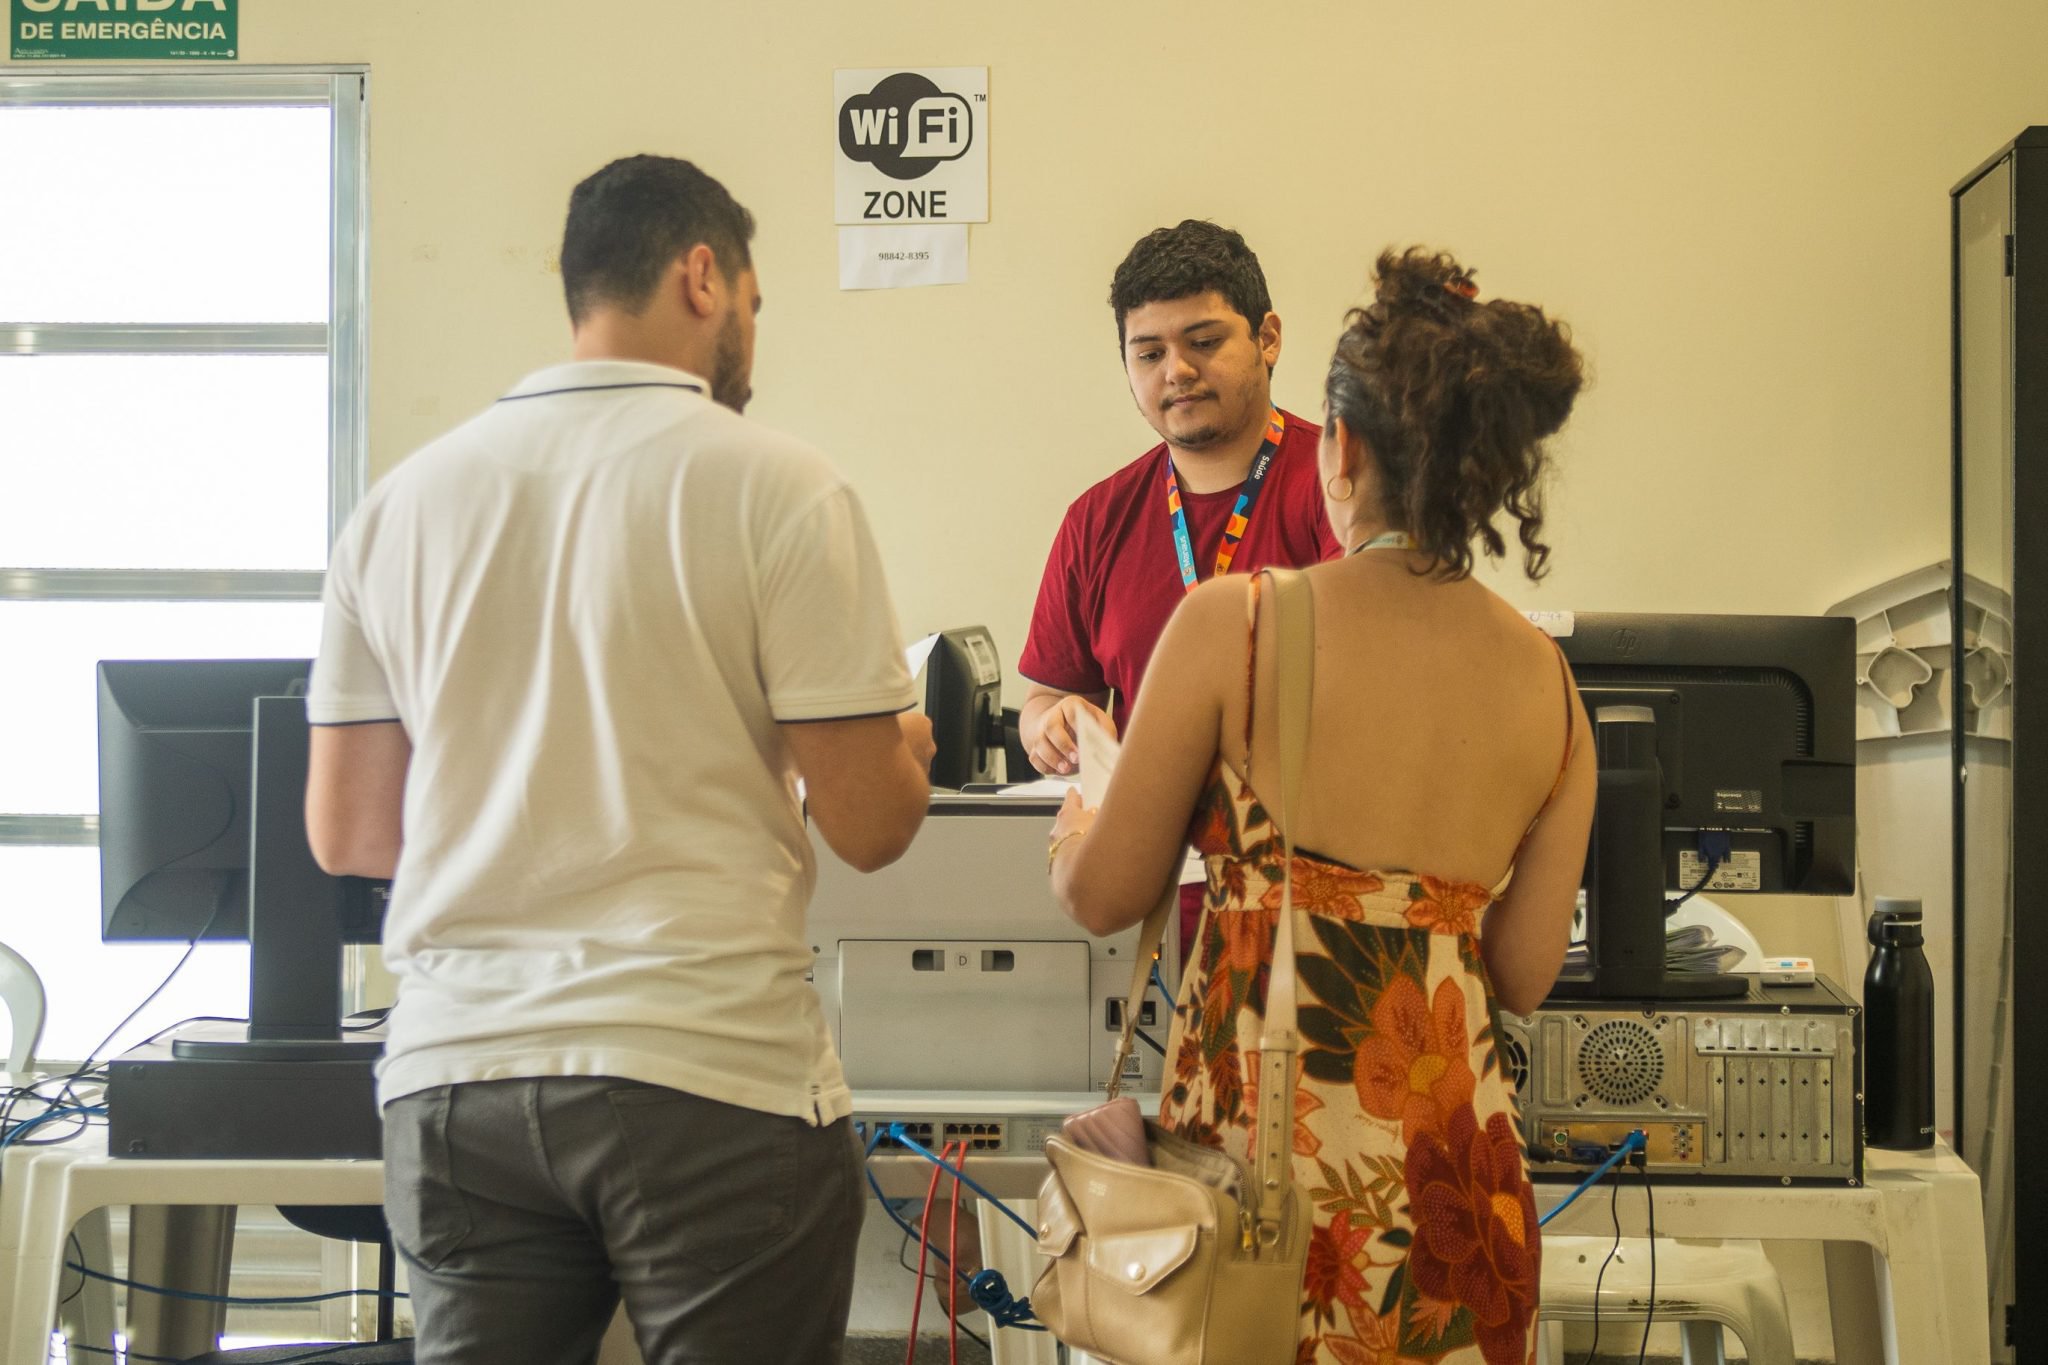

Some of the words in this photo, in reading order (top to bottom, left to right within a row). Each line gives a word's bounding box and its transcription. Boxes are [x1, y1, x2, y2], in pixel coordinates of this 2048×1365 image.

[20, 22, 54, 40] DE
[61, 18, 227, 40] EMERGÊNCIA
[974, 94, 987, 103] TM
[863, 190, 948, 219] ZONE
[878, 251, 930, 262] 98842-8395
[1254, 455, 1270, 480] Saúde
[958, 955, 968, 966] D
